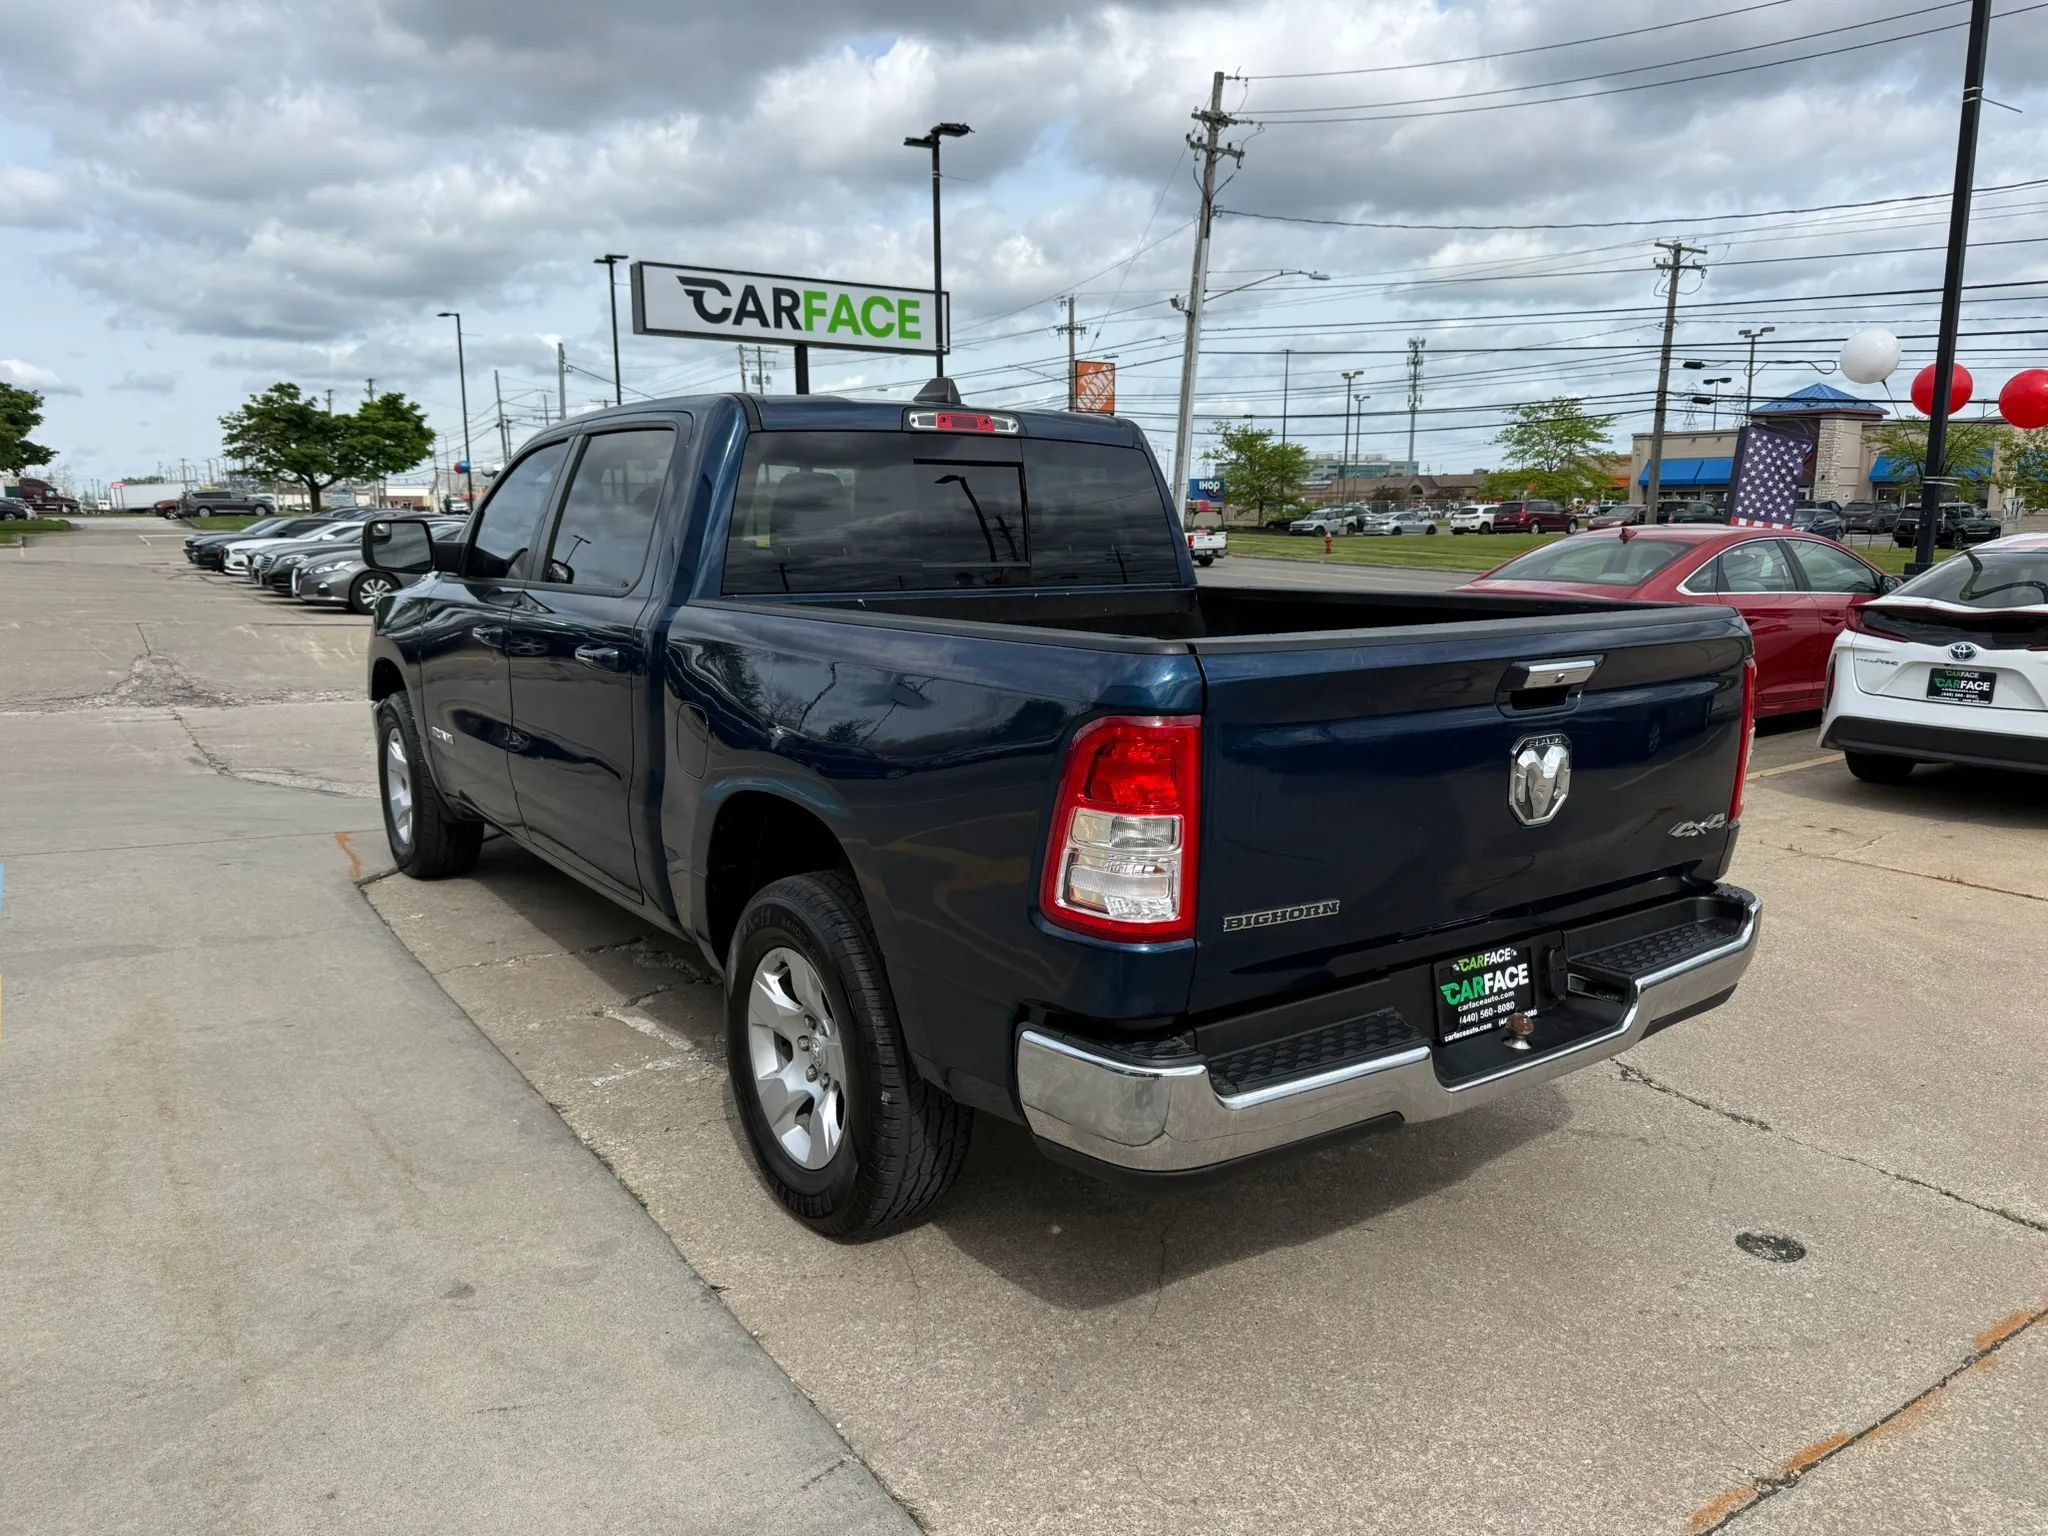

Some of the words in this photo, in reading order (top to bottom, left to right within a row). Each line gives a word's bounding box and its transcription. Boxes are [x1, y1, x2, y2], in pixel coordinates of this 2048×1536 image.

[676, 275, 922, 340] CARFACE
[1935, 677, 1991, 692] CARFACE
[1223, 900, 1340, 932] BIGHORN
[1458, 947, 1512, 972] CARFACE
[1440, 963, 1529, 1005] CARFACE
[1458, 990, 1515, 1012] carfaceauto.com
[1459, 1012, 1479, 1024] (440)
